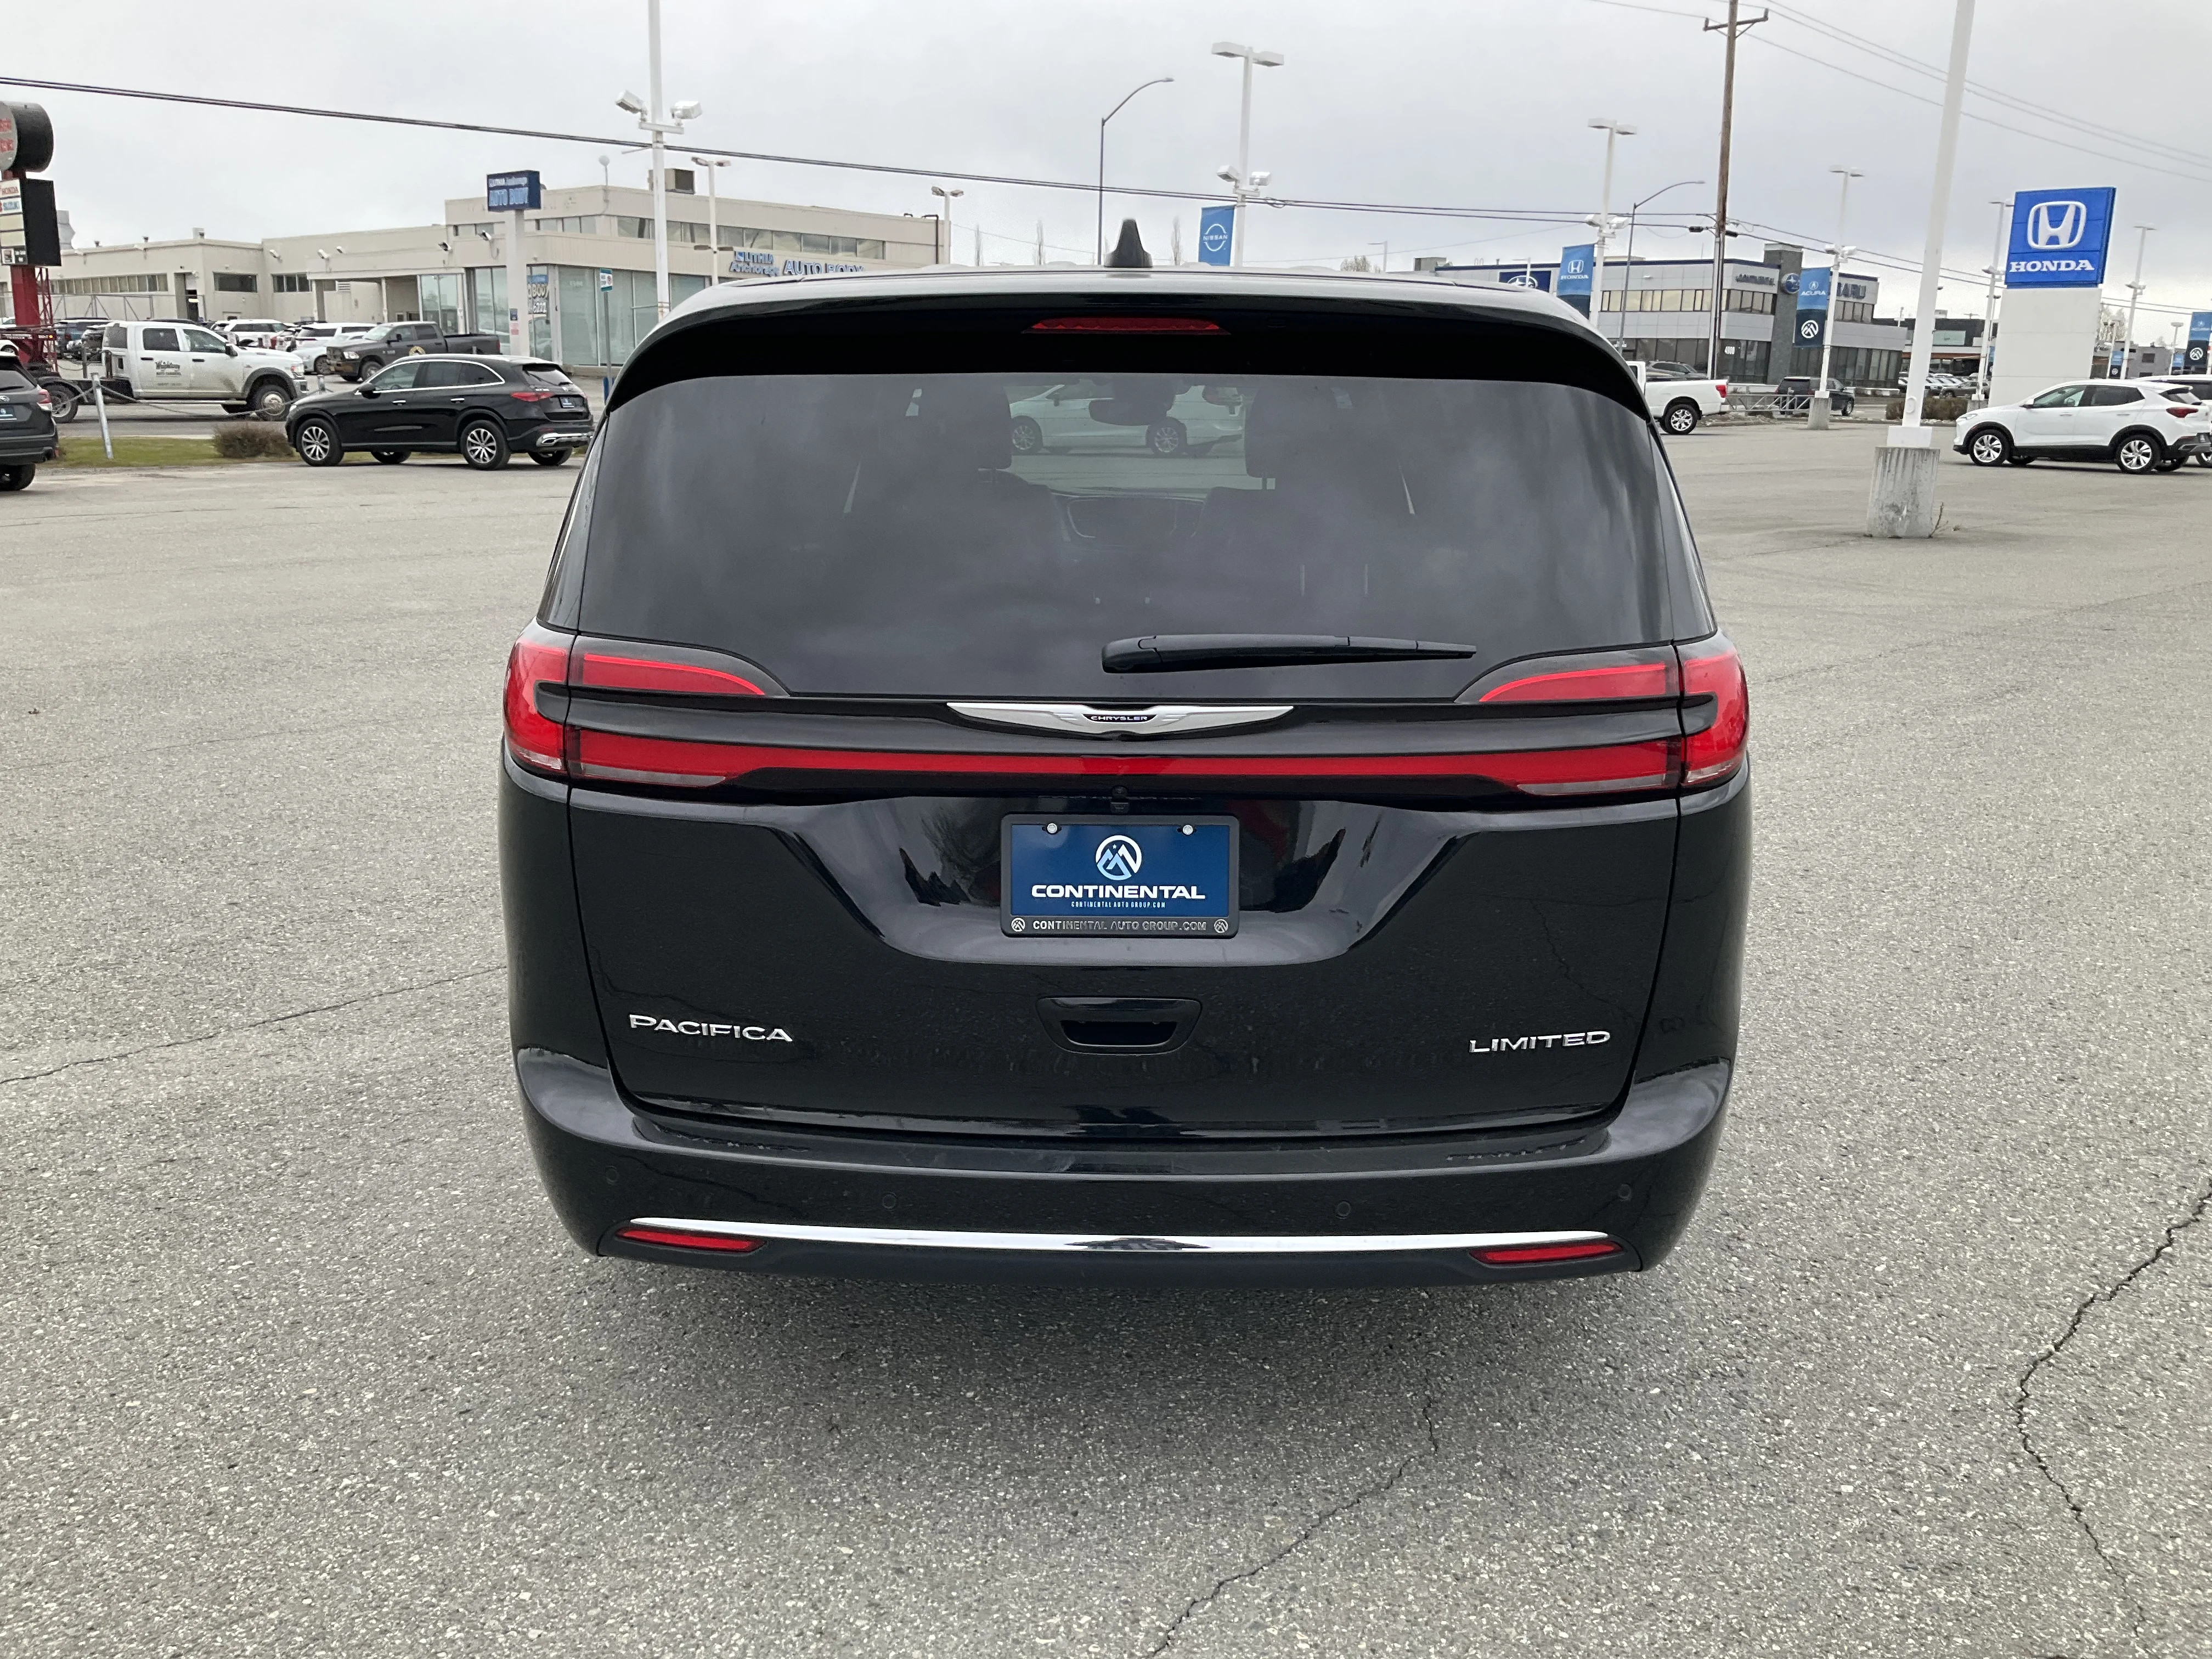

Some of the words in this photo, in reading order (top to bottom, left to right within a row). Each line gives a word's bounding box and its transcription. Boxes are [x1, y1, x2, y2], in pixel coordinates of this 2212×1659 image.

[744, 252, 775, 264] LITHIA
[783, 259, 822, 275] AUTO
[2009, 259, 2095, 273] HONDA
[1031, 884, 1206, 899] CONTINENTAL
[1032, 920, 1108, 930] CONTINENTAL
[1110, 921, 1139, 930] AUTO
[629, 1014, 793, 1042] PACIFICA
[1468, 1030, 1611, 1053] LIMITED
